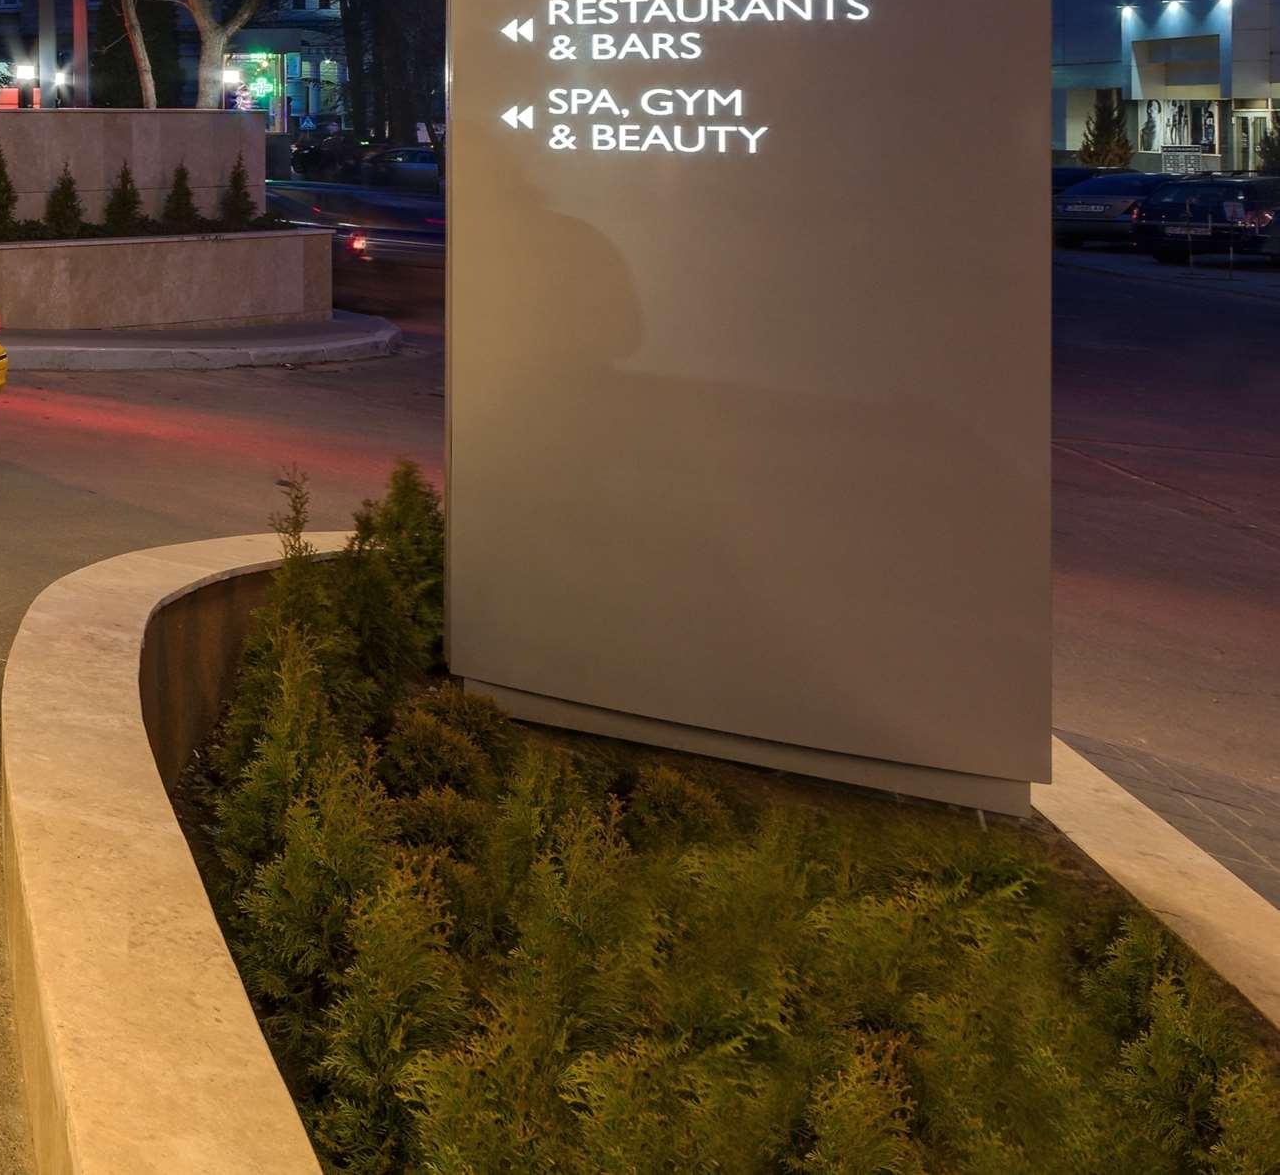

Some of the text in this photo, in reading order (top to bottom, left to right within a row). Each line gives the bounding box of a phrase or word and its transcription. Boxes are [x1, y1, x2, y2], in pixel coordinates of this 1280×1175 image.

[548, 33, 703, 61] & BARS
[547, 89, 743, 117] SPA, GYM
[548, 125, 769, 154] & BEAUTY
